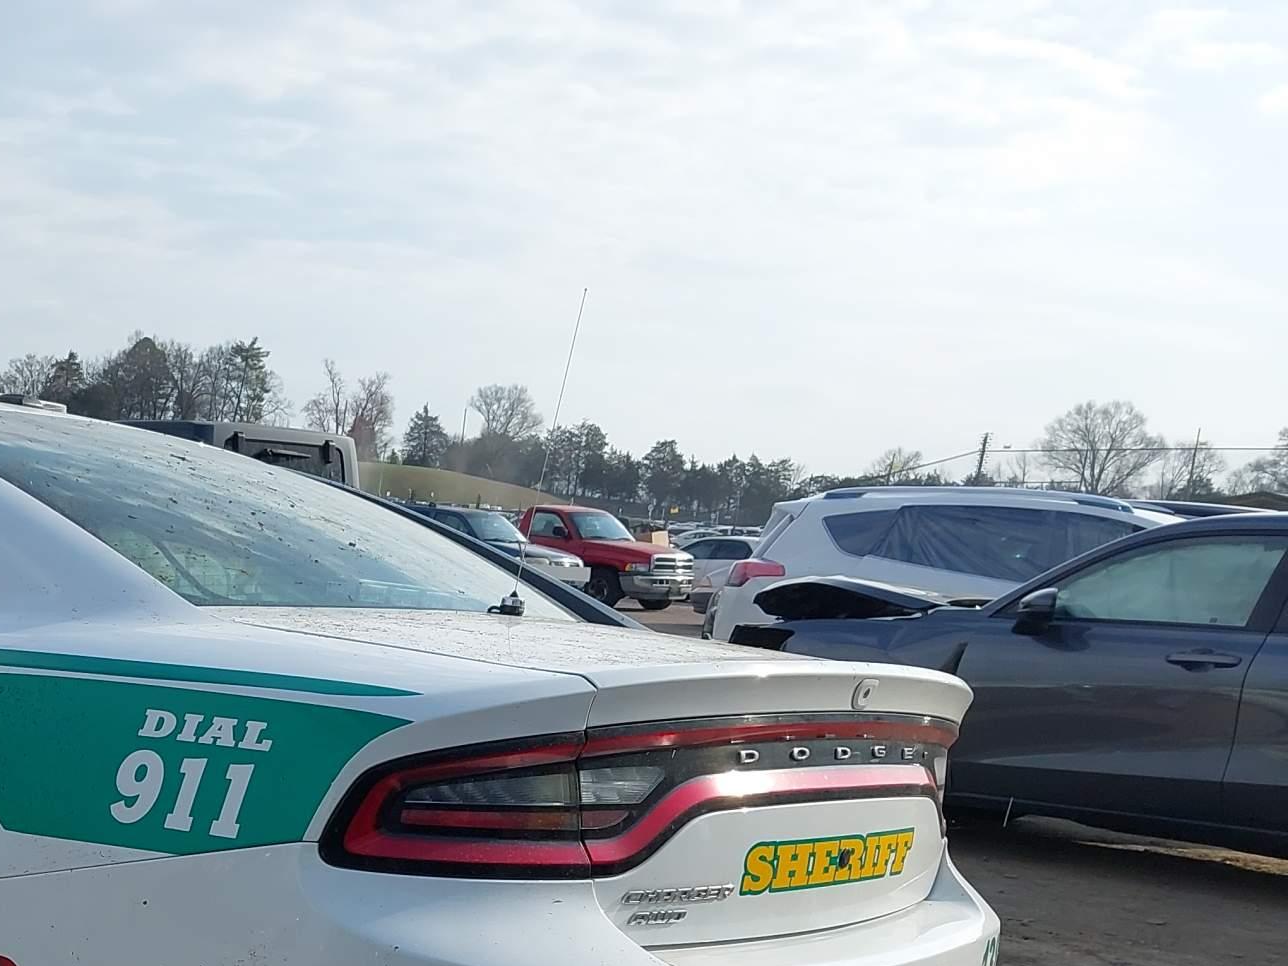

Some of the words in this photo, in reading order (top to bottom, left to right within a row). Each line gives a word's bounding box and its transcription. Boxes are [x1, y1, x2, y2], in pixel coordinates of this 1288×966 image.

[138, 709, 272, 752] DIAL
[739, 745, 916, 764] DODGE
[110, 750, 255, 839] 911
[740, 829, 914, 895] SHERIFF
[621, 884, 734, 905] CHARGER
[626, 910, 688, 926] AWD
